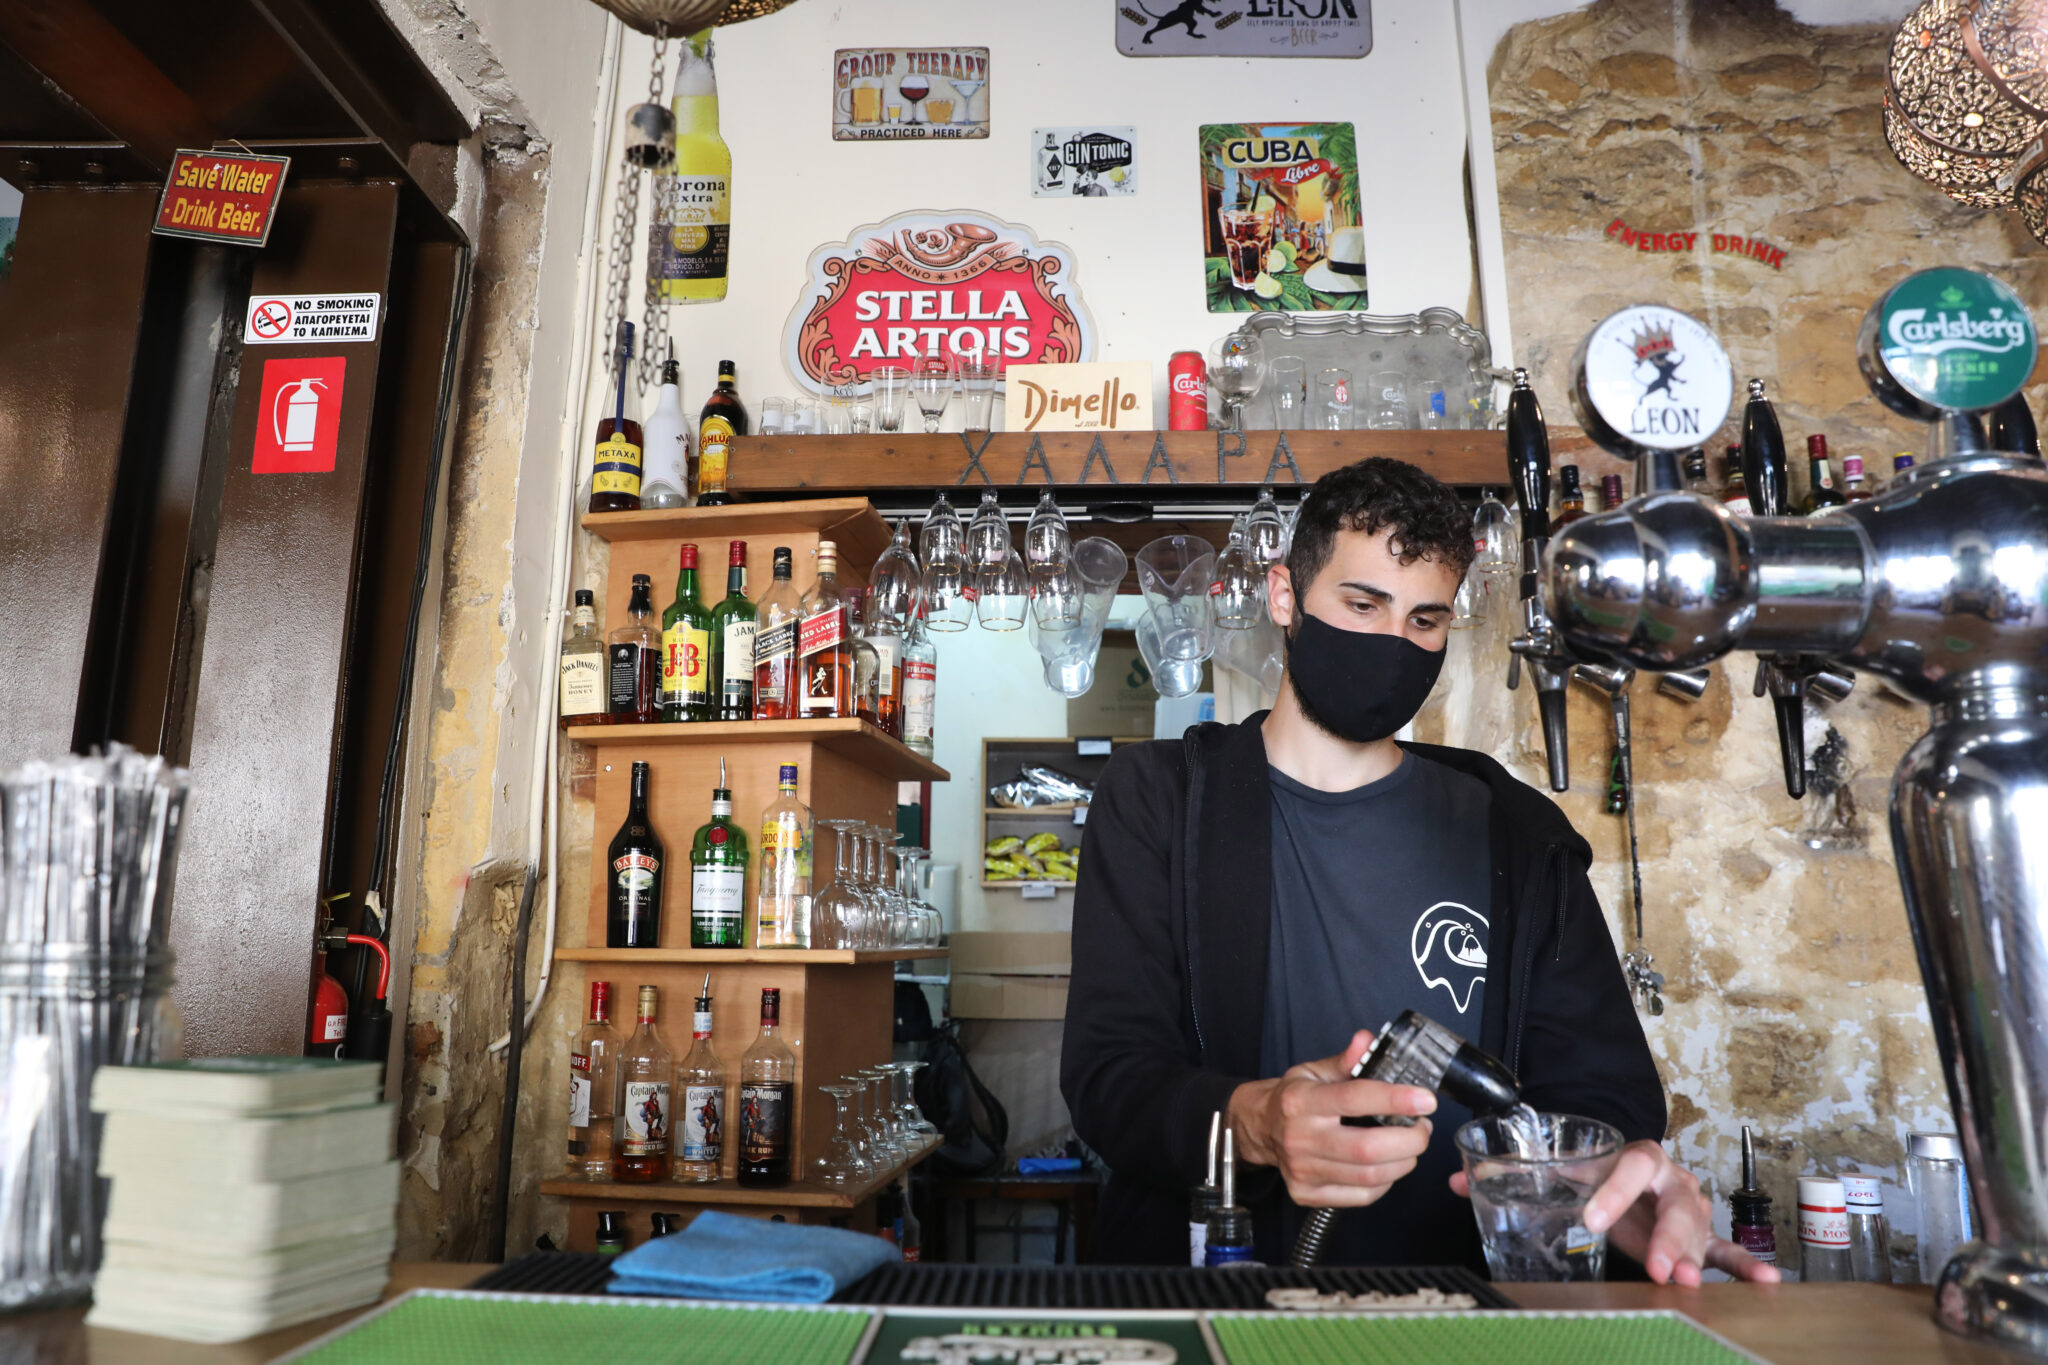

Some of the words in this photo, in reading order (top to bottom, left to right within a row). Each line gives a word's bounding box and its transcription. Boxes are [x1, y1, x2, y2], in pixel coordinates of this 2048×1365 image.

[837, 53, 896, 88] GROUP
[907, 53, 987, 80] THERAPY
[860, 128, 925, 138] PRACTICED
[933, 129, 962, 138] HERE
[1227, 140, 1313, 164] CUBA
[175, 160, 219, 189] Save
[220, 163, 273, 195] Water
[1281, 162, 1320, 184] Libre
[675, 181, 725, 191] orona
[171, 197, 215, 228] Drink
[217, 202, 261, 233] Beer.
[1606, 218, 1698, 251] ENERGY
[1712, 233, 1788, 269] DRINK
[895, 260, 931, 279] ANNO
[953, 260, 987, 279] 1366
[294, 300, 311, 310] NO
[317, 298, 374, 310] SMOKING
[855, 290, 1031, 321] STELLA
[294, 313, 370, 325] ΑΠΑΓΟΡΕΥΕΤΑΙ
[293, 327, 307, 337] ΤΟ
[311, 326, 368, 337] ΚΑΠΝΙΣΜΑ
[1888, 308, 2026, 355] Carlsberg
[850, 327, 1031, 358] ARTOIS
[1938, 361, 1999, 374] ILSNER
[1018, 377, 1137, 431] Dimello
[1630, 407, 1699, 435] LEON
[598, 449, 636, 460] METAXA
[775, 630, 795, 642] LABEL
[800, 630, 815, 640] RED
[816, 620, 840, 633] LABEL
[561, 663, 576, 674] JACK
[616, 856, 656, 870] BAEYS
[631, 1085, 655, 1098] Captain
[689, 1090, 712, 1102] Captain
[757, 1088, 781, 1101] Morgan
[1848, 1191, 1874, 1199] LOEL
